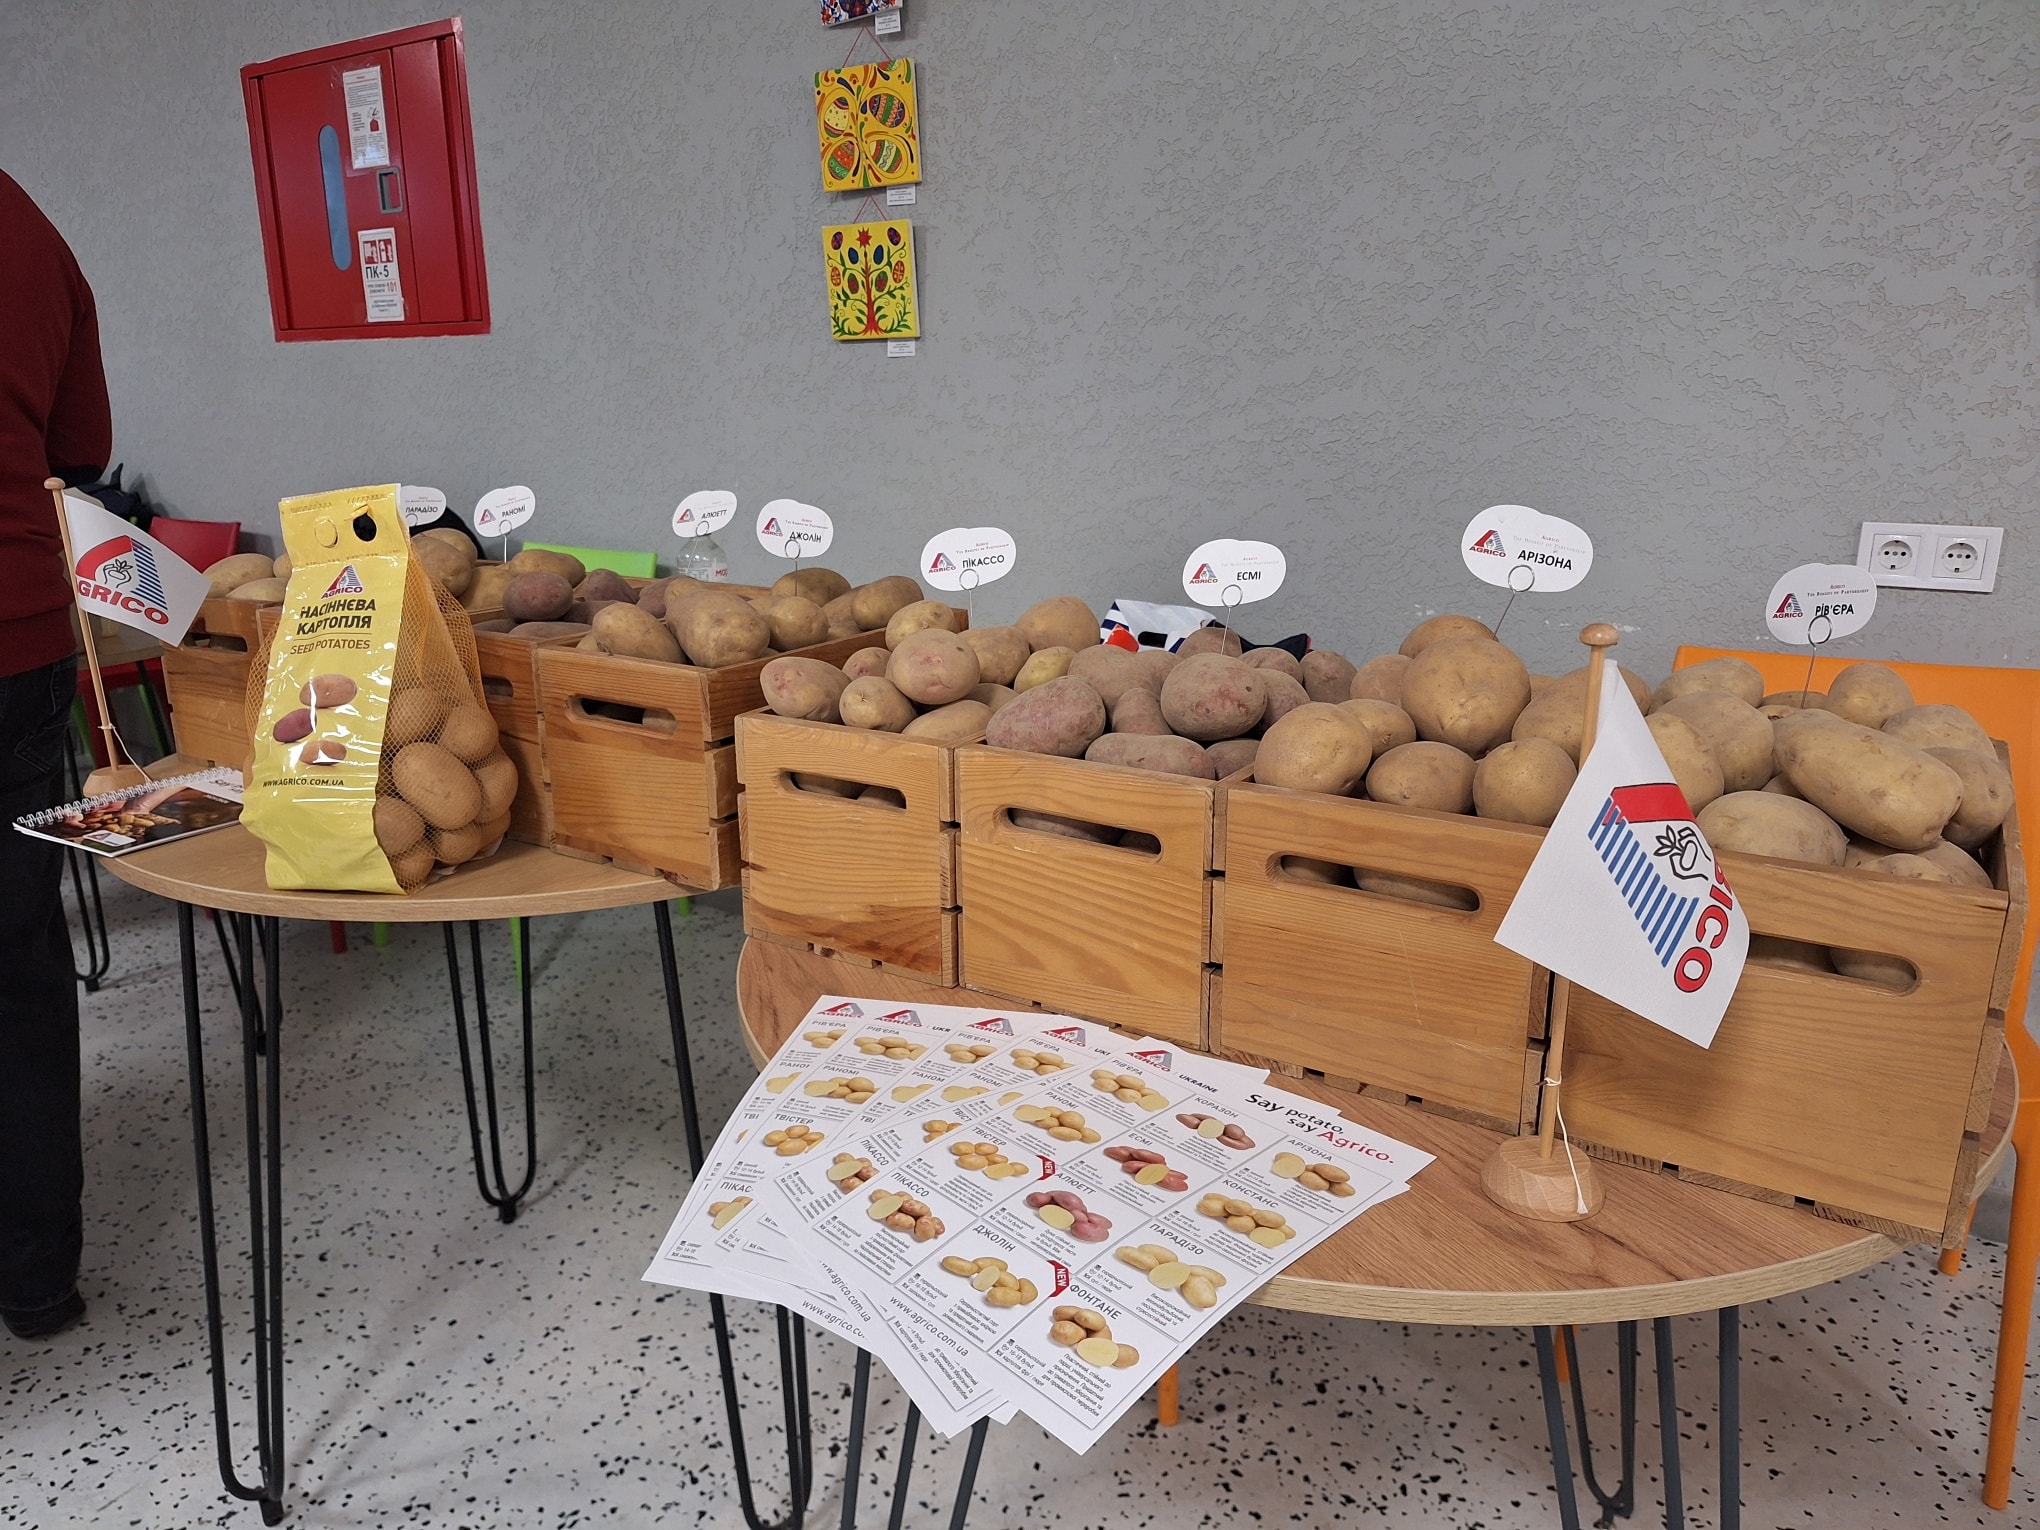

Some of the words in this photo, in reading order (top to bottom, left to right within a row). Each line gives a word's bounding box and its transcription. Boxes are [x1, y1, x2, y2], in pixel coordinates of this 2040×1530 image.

[366, 265, 389, 279] ПК-5
[502, 506, 526, 518] РАНОМІ
[702, 510, 728, 519] АЛЮЕТТ
[1469, 546, 1506, 558] AGRICO
[1518, 550, 1572, 570] АРІЗОНА
[962, 554, 1004, 568] ПІКАССО
[1237, 571, 1261, 580] ЕСМІ
[321, 586, 363, 599] AGRICO
[300, 599, 376, 620] НАСІННЄВА
[296, 615, 372, 635] КАРТОПЛЯ
[290, 643, 314, 655] SEED
[315, 639, 370, 652] POTATOES
[263, 778, 344, 788] WWW.AGRICO.COM.UA
[866, 1026, 900, 1036] РІВ'ЄРА
[874, 1017, 923, 1028] AGRICO
[967, 1024, 1015, 1037] AGRICO
[958, 1032, 991, 1044] РІВ'ЄРА
[1029, 1038, 1060, 1052] РІВ'ЄРА
[1040, 1031, 1086, 1047] AGRICO
[822, 1066, 860, 1075] РАНОМІ
[1112, 1059, 1144, 1076] РІВ'ЄРА
[1125, 1051, 1171, 1072] AGRICO
[1179, 1074, 1220, 1093] UKRAINE
[969, 1072, 1003, 1088] РАНОМІ
[1046, 1091, 1079, 1110] РАНОМІ
[1194, 1097, 1239, 1118] КОРАЗОН
[774, 1113, 814, 1125] ТВІСТЕР
[1245, 1093, 1285, 1112] Say
[1285, 1108, 1344, 1134] potato,
[971, 1126, 1007, 1146] ТВІСТЕР
[1128, 1132, 1152, 1146] ЕСМІ
[1288, 1117, 1318, 1133] say
[1317, 1131, 1395, 1164] Agrico.
[860, 1139, 889, 1166] ПІКАССО
[1287, 1139, 1333, 1162] АРІЗОНА
[891, 1172, 930, 1197] ПІКАССО
[1055, 1172, 1097, 1195] АЛЮЕТТ
[1222, 1180, 1279, 1208] КОНСТАНС
[972, 1224, 1016, 1252] ДЖОЛІН
[1150, 1223, 1204, 1256] ПАРАДІЗО
[1057, 1268, 1067, 1287] NEW
[1070, 1284, 1122, 1320] ФОНТАНЕ
[890, 1296, 969, 1357] www.agrico.com.ua
